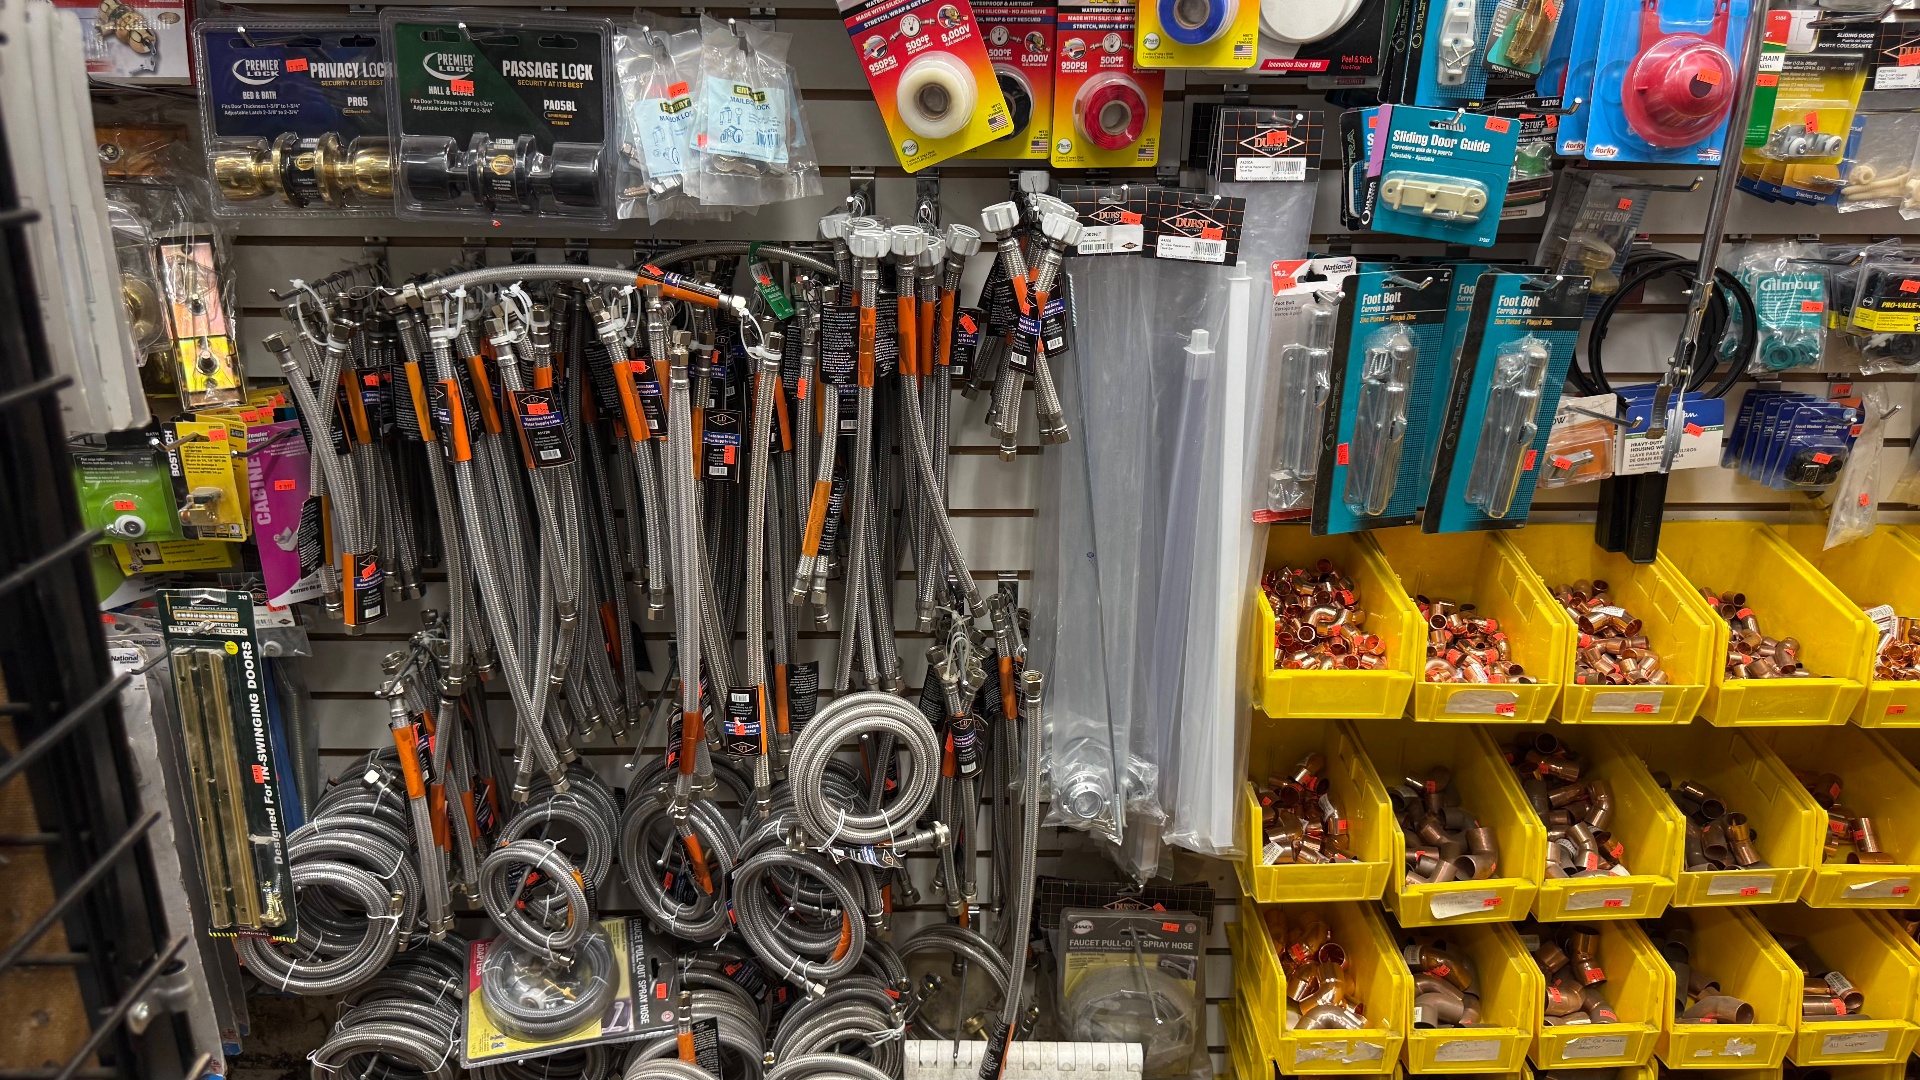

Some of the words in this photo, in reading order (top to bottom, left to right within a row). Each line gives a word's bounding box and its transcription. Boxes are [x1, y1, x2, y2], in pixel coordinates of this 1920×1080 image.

[856, 12, 871, 22] MADE
[871, 6, 886, 15] WITH
[864, 14, 890, 28] STRETCH,
[889, 7, 906, 17] WRAP
[941, 24, 970, 43] 8,000V
[245, 60, 279, 71] PREMIER
[438, 54, 474, 66] PREMIER
[869, 55, 897, 72] 950PSI
[1021, 54, 1048, 63] 8,000V
[1342, 55, 1354, 63] Peel
[1354, 55, 1358, 63] &
[1359, 56, 1372, 64] Stick
[310, 62, 359, 78] PRIVACY
[502, 60, 558, 79] PASSAGE
[562, 63, 594, 80] LOCK
[243, 91, 254, 99] BED
[262, 91, 277, 100] BATH
[429, 86, 444, 95] HALL
[446, 86, 450, 95] &
[1393, 130, 1428, 146] Sliding
[1430, 134, 1457, 149] Door
[1460, 138, 1490, 153] Guide
[1566, 142, 1584, 150] korky
[1390, 152, 1412, 160] Adjustable
[1100, 211, 1121, 220] DURS
[1582, 210, 1602, 220] INLET
[1603, 211, 1630, 222] ELBOW
[1176, 218, 1210, 228] DURST
[1323, 262, 1352, 271] National
[1459, 284, 1476, 294] Foo
[1760, 278, 1820, 291] Gilmour
[1363, 293, 1382, 304] Foot
[1384, 292, 1401, 303] Bolt
[1498, 296, 1519, 307] Foot
[1521, 296, 1540, 307] Bolt
[249, 453, 271, 526] CABINE
[242, 642, 257, 690] DOORS
[250, 693, 271, 780] IN-SWINGING
[265, 784, 273, 804] For
[265, 807, 283, 864] Designed
[634, 919, 643, 943] FAUCET
[636, 944, 645, 978] PULL-OUT
[638, 980, 648, 1004] SPRAY
[640, 1006, 649, 1025] HOSE
